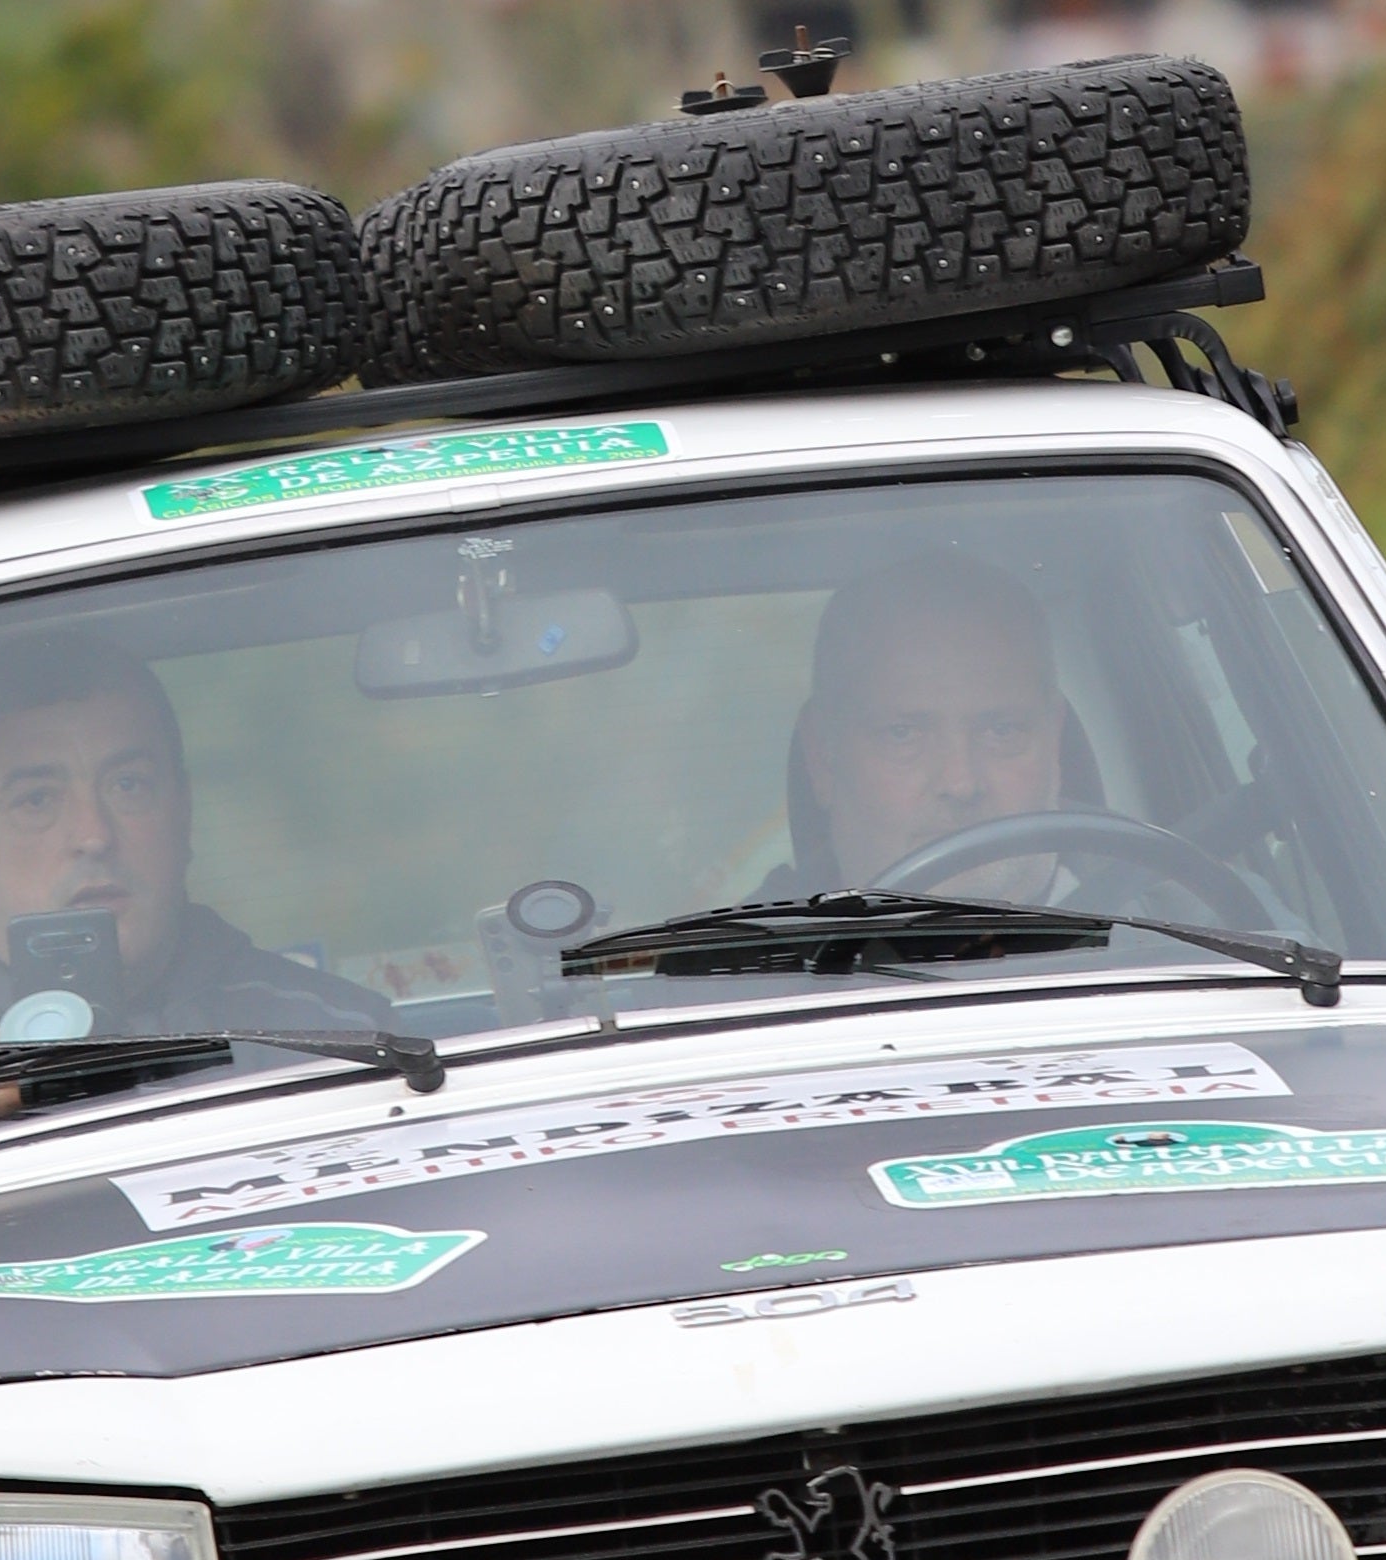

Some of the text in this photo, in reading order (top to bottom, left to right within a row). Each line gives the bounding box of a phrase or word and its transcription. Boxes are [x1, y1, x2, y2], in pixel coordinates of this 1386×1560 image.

[466, 426, 633, 449] VILLA
[278, 469, 353, 490] DE
[368, 437, 642, 477] AZPEITIA
[175, 1082, 1258, 1220] AZPEITIKO ERRETEGIA
[285, 1241, 429, 1260] VILLA
[71, 1273, 148, 1290] DE
[149, 1260, 398, 1285] AZPEITIA
[671, 1278, 917, 1328] 504
